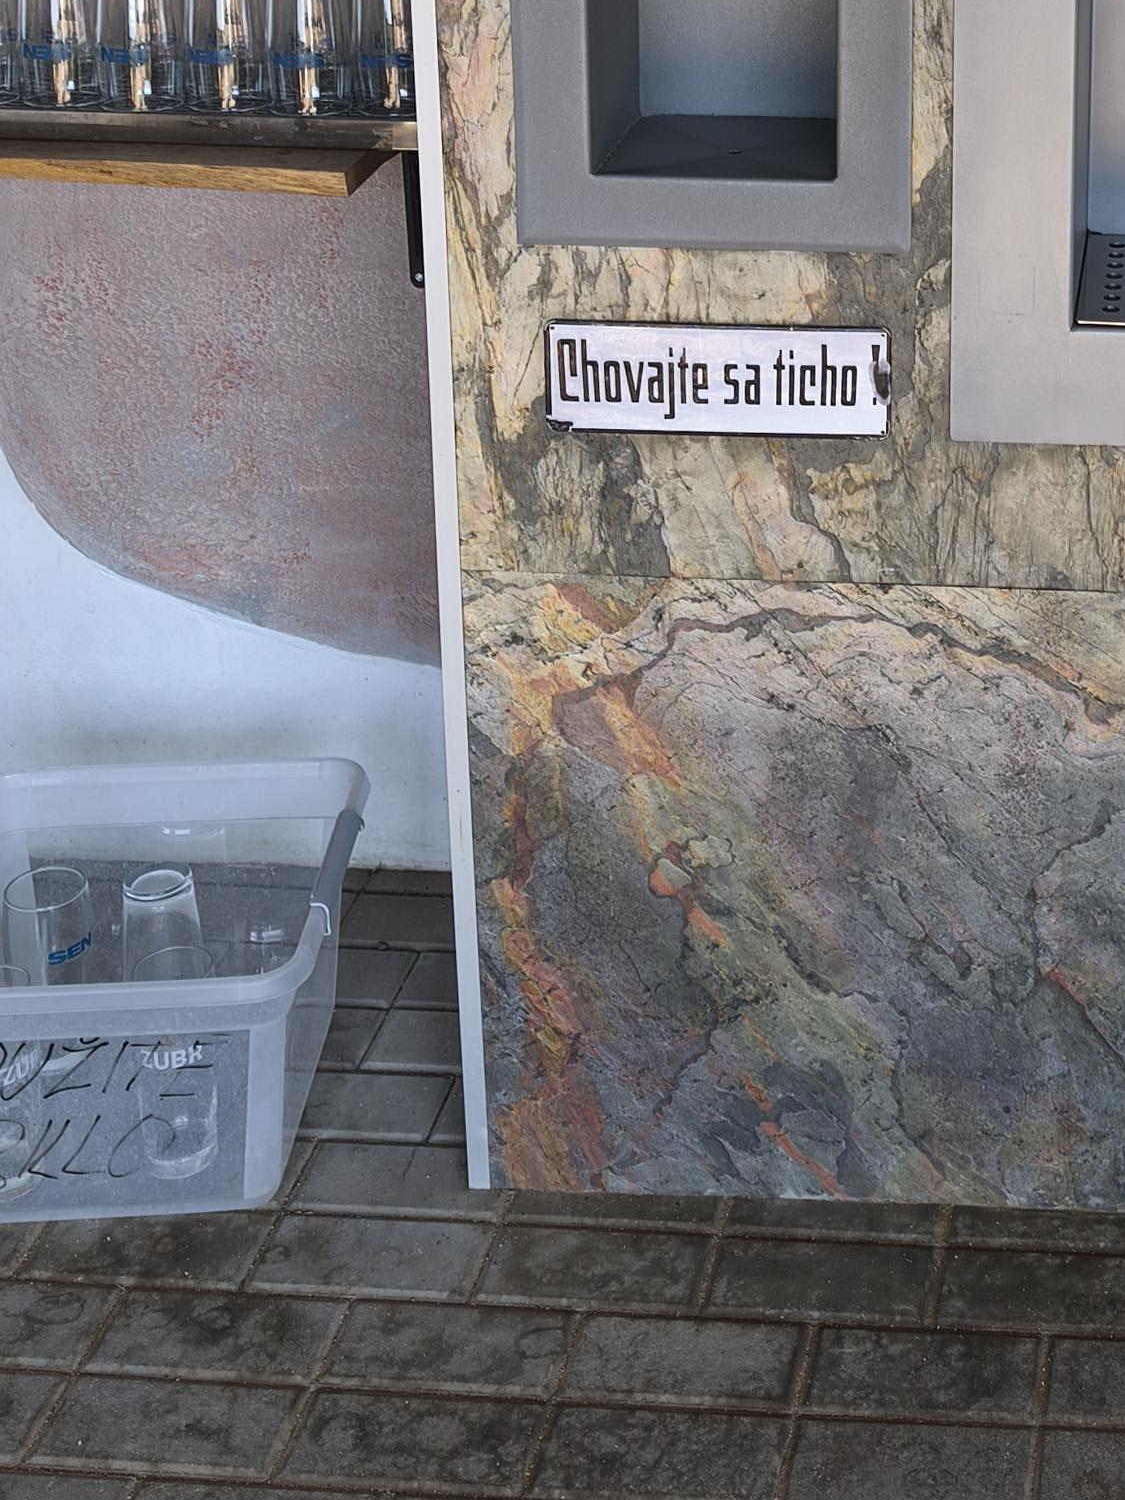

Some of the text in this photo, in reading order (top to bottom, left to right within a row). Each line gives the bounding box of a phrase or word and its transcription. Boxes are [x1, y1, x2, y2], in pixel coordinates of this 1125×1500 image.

[557, 338, 709, 420] Chovajte
[724, 364, 761, 405] sa
[774, 344, 858, 406] ticho
[48, 932, 91, 965] SEN
[0, 1036, 229, 1101] UŽITE
